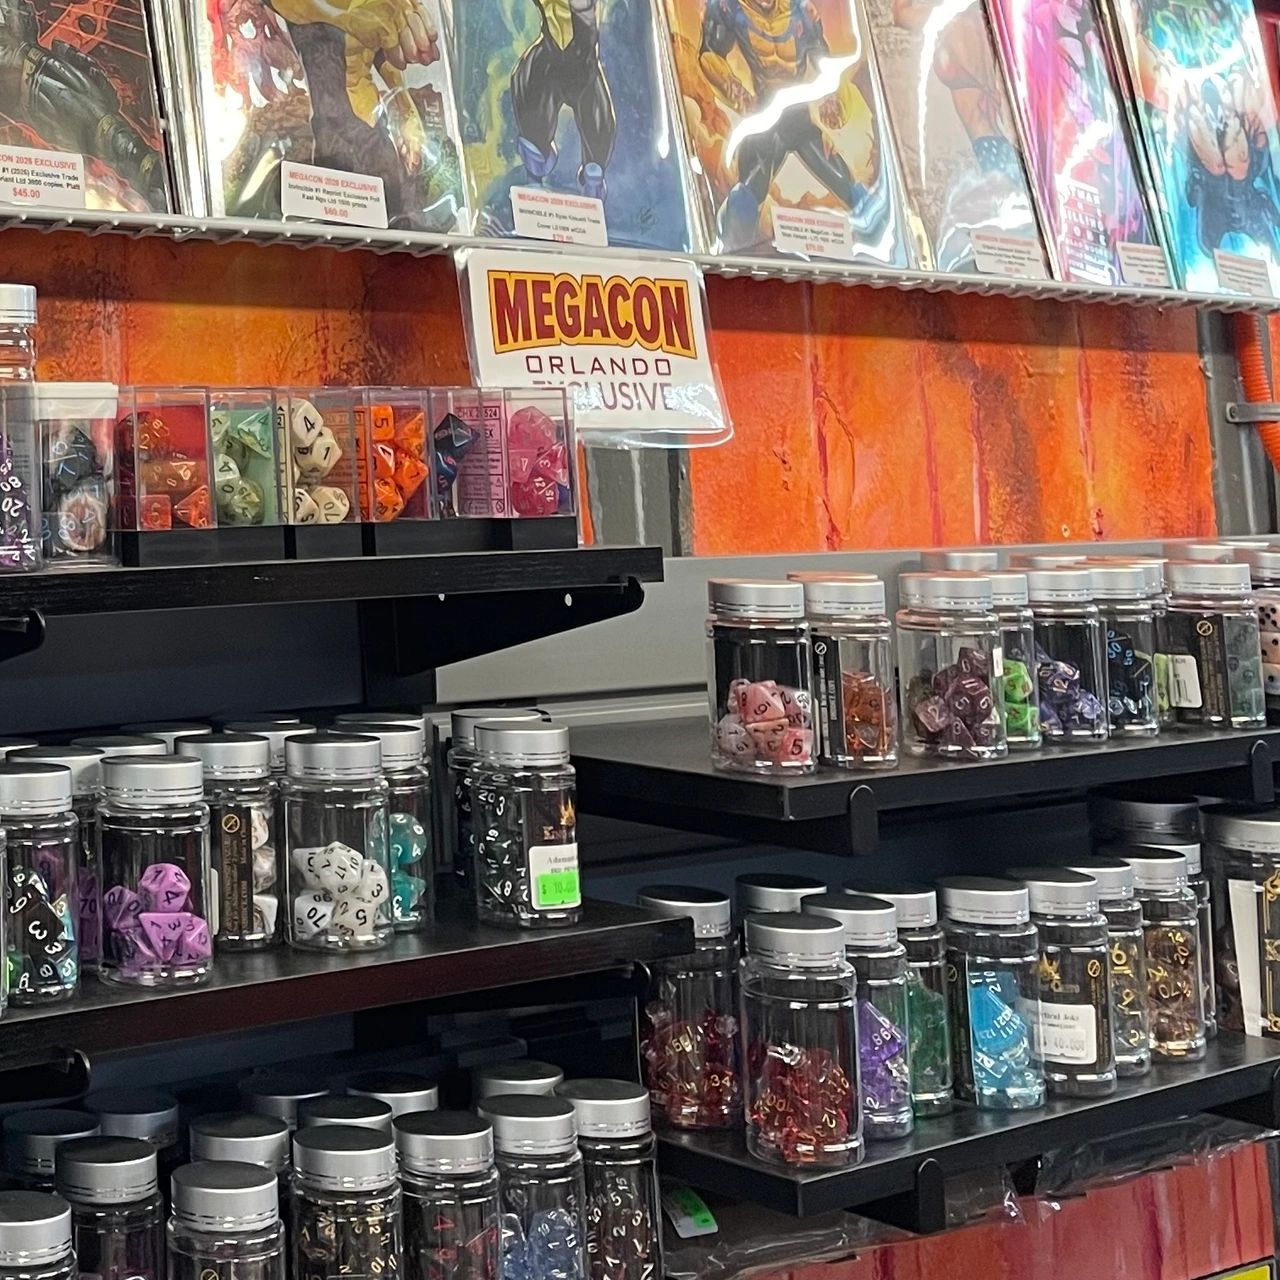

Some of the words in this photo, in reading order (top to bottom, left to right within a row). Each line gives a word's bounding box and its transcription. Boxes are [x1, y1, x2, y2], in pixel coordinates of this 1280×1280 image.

[34, 158, 77, 170] EXCLUSIVE
[490, 274, 694, 354] MEGACON
[525, 355, 672, 376] ORLANDO
